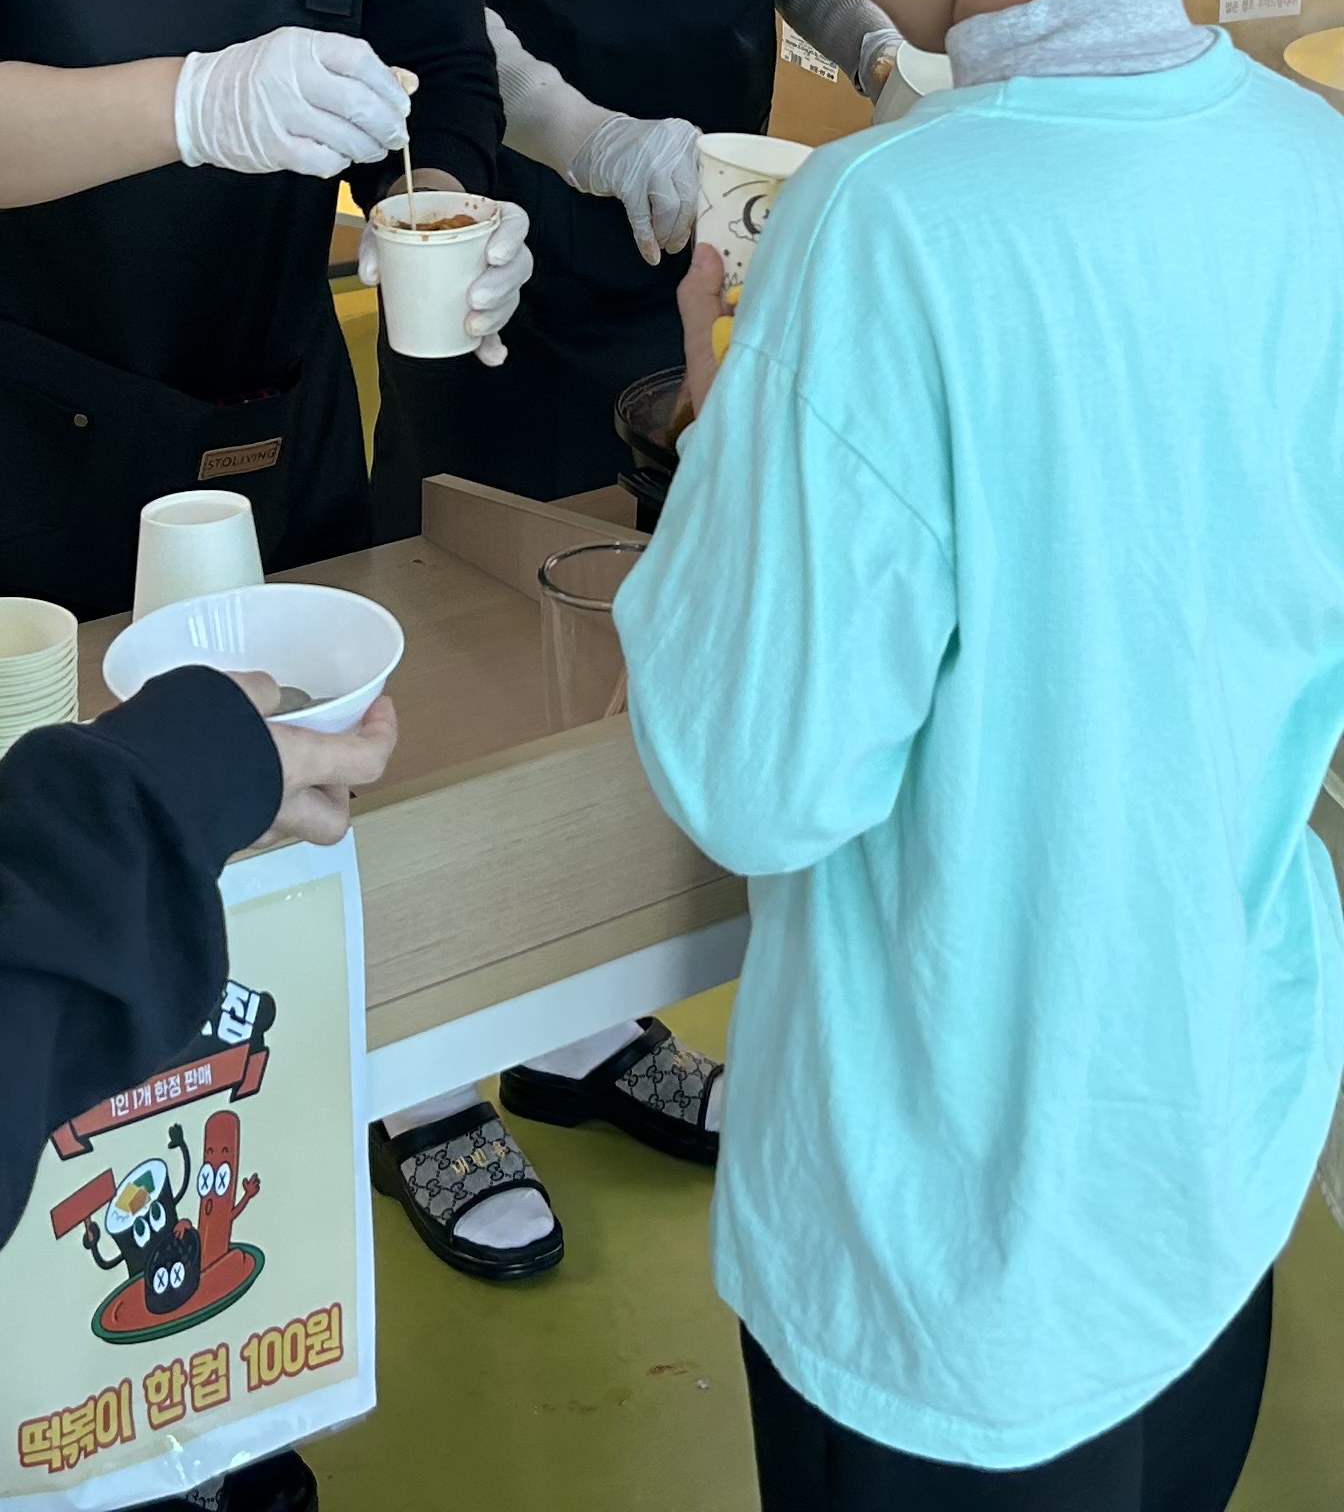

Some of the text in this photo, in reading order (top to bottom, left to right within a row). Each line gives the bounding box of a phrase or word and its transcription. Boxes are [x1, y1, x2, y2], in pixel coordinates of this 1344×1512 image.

[110, 1063, 212, 1118] 1인 1개 한정 판매
[17, 1370, 136, 1474] 떡볶이
[240, 1301, 344, 1390] 100원
